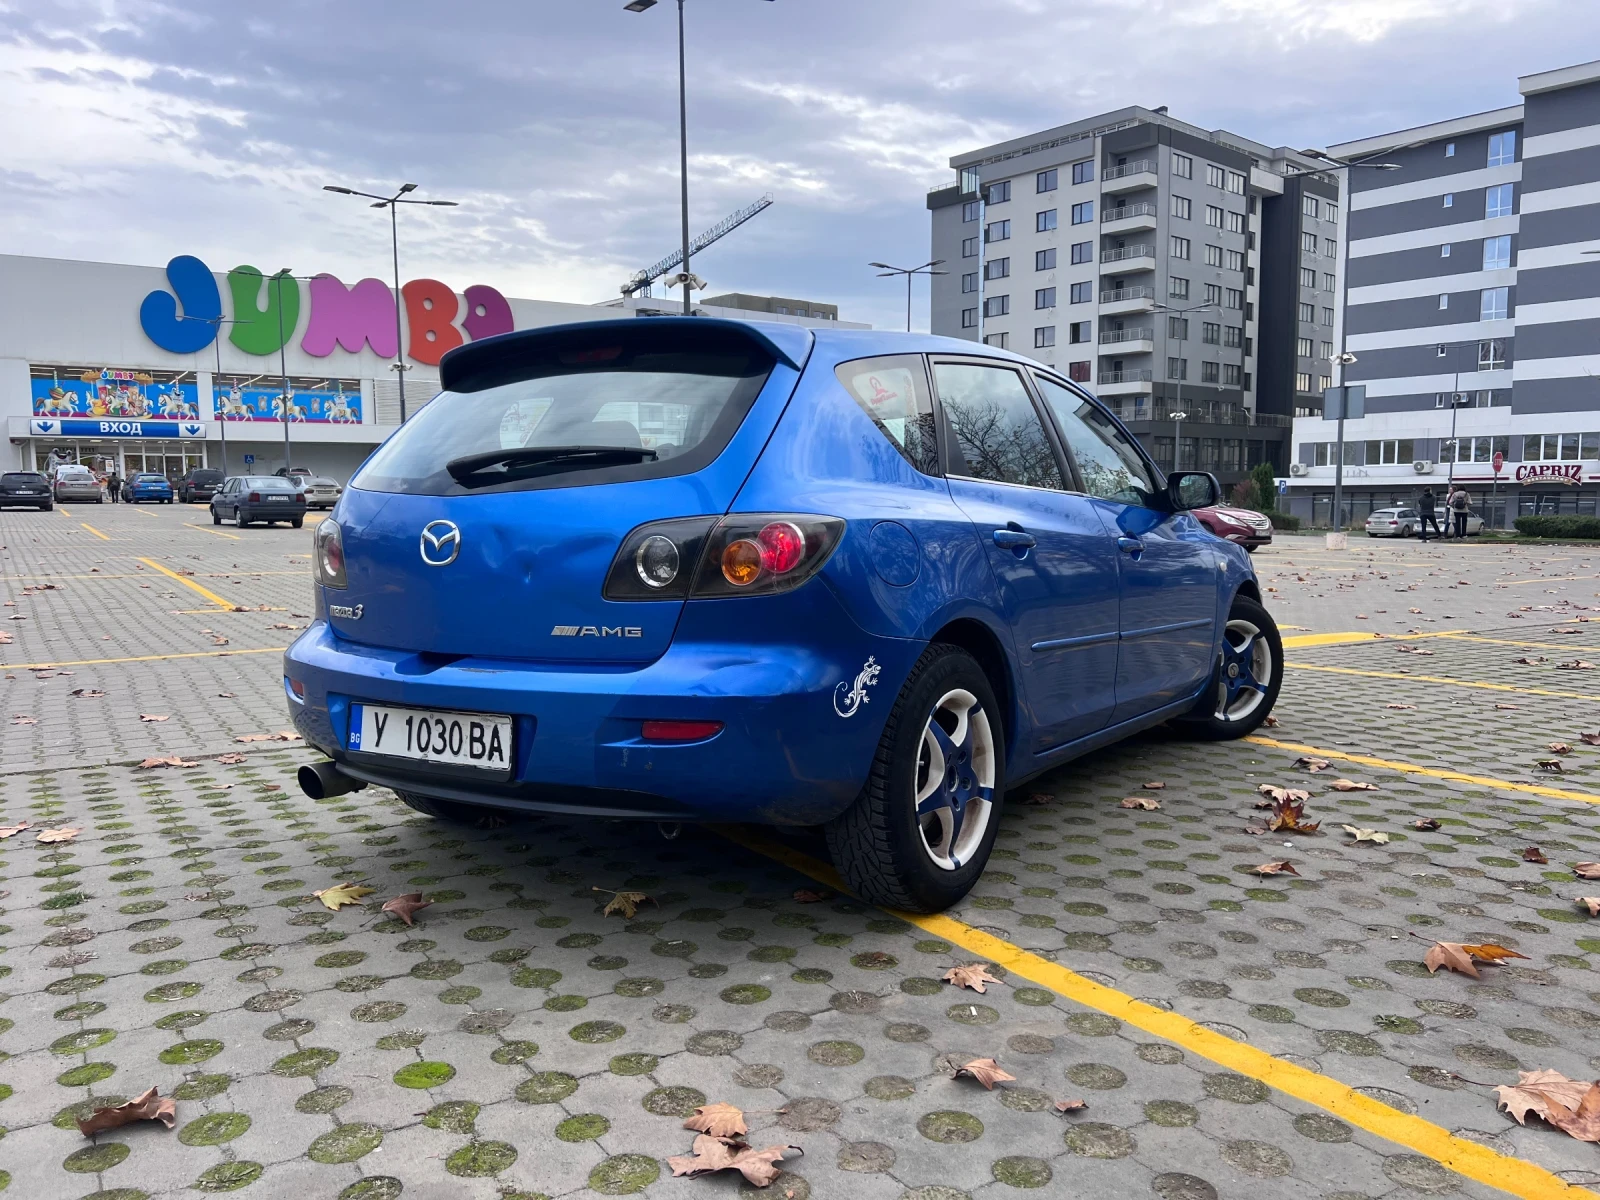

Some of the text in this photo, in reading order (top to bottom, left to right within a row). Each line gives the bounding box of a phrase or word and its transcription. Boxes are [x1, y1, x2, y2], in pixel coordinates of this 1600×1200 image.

[101, 371, 134, 380] JUMBO
[100, 422, 142, 435] ВХОД
[1516, 465, 1582, 486] CAPRIZ
[353, 603, 364, 620] 3
[580, 626, 642, 637] AMG
[350, 732, 361, 744] BG
